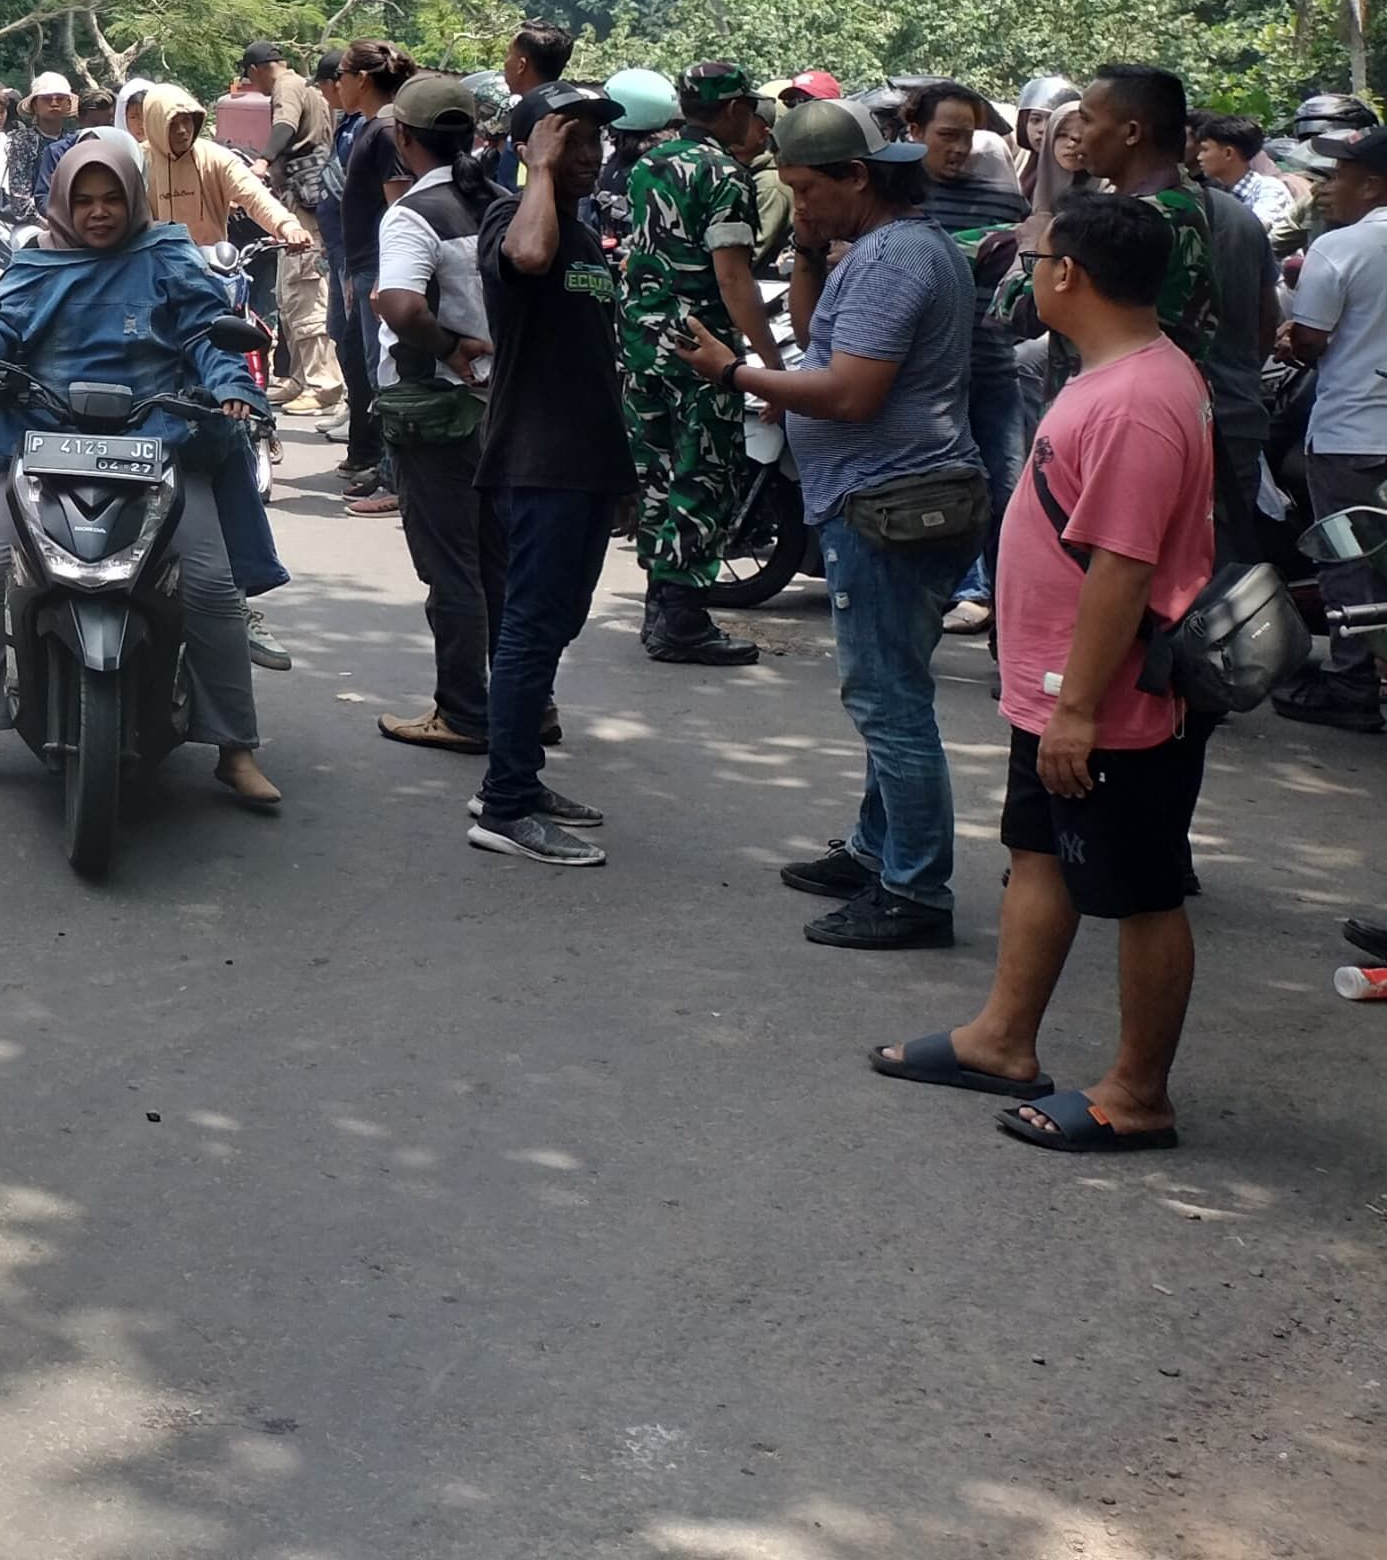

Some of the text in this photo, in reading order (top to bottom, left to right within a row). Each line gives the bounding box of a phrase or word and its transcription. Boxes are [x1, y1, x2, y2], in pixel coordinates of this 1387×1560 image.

[31, 438, 154, 459] P 4125 JC
[1058, 831, 1086, 865] NY
